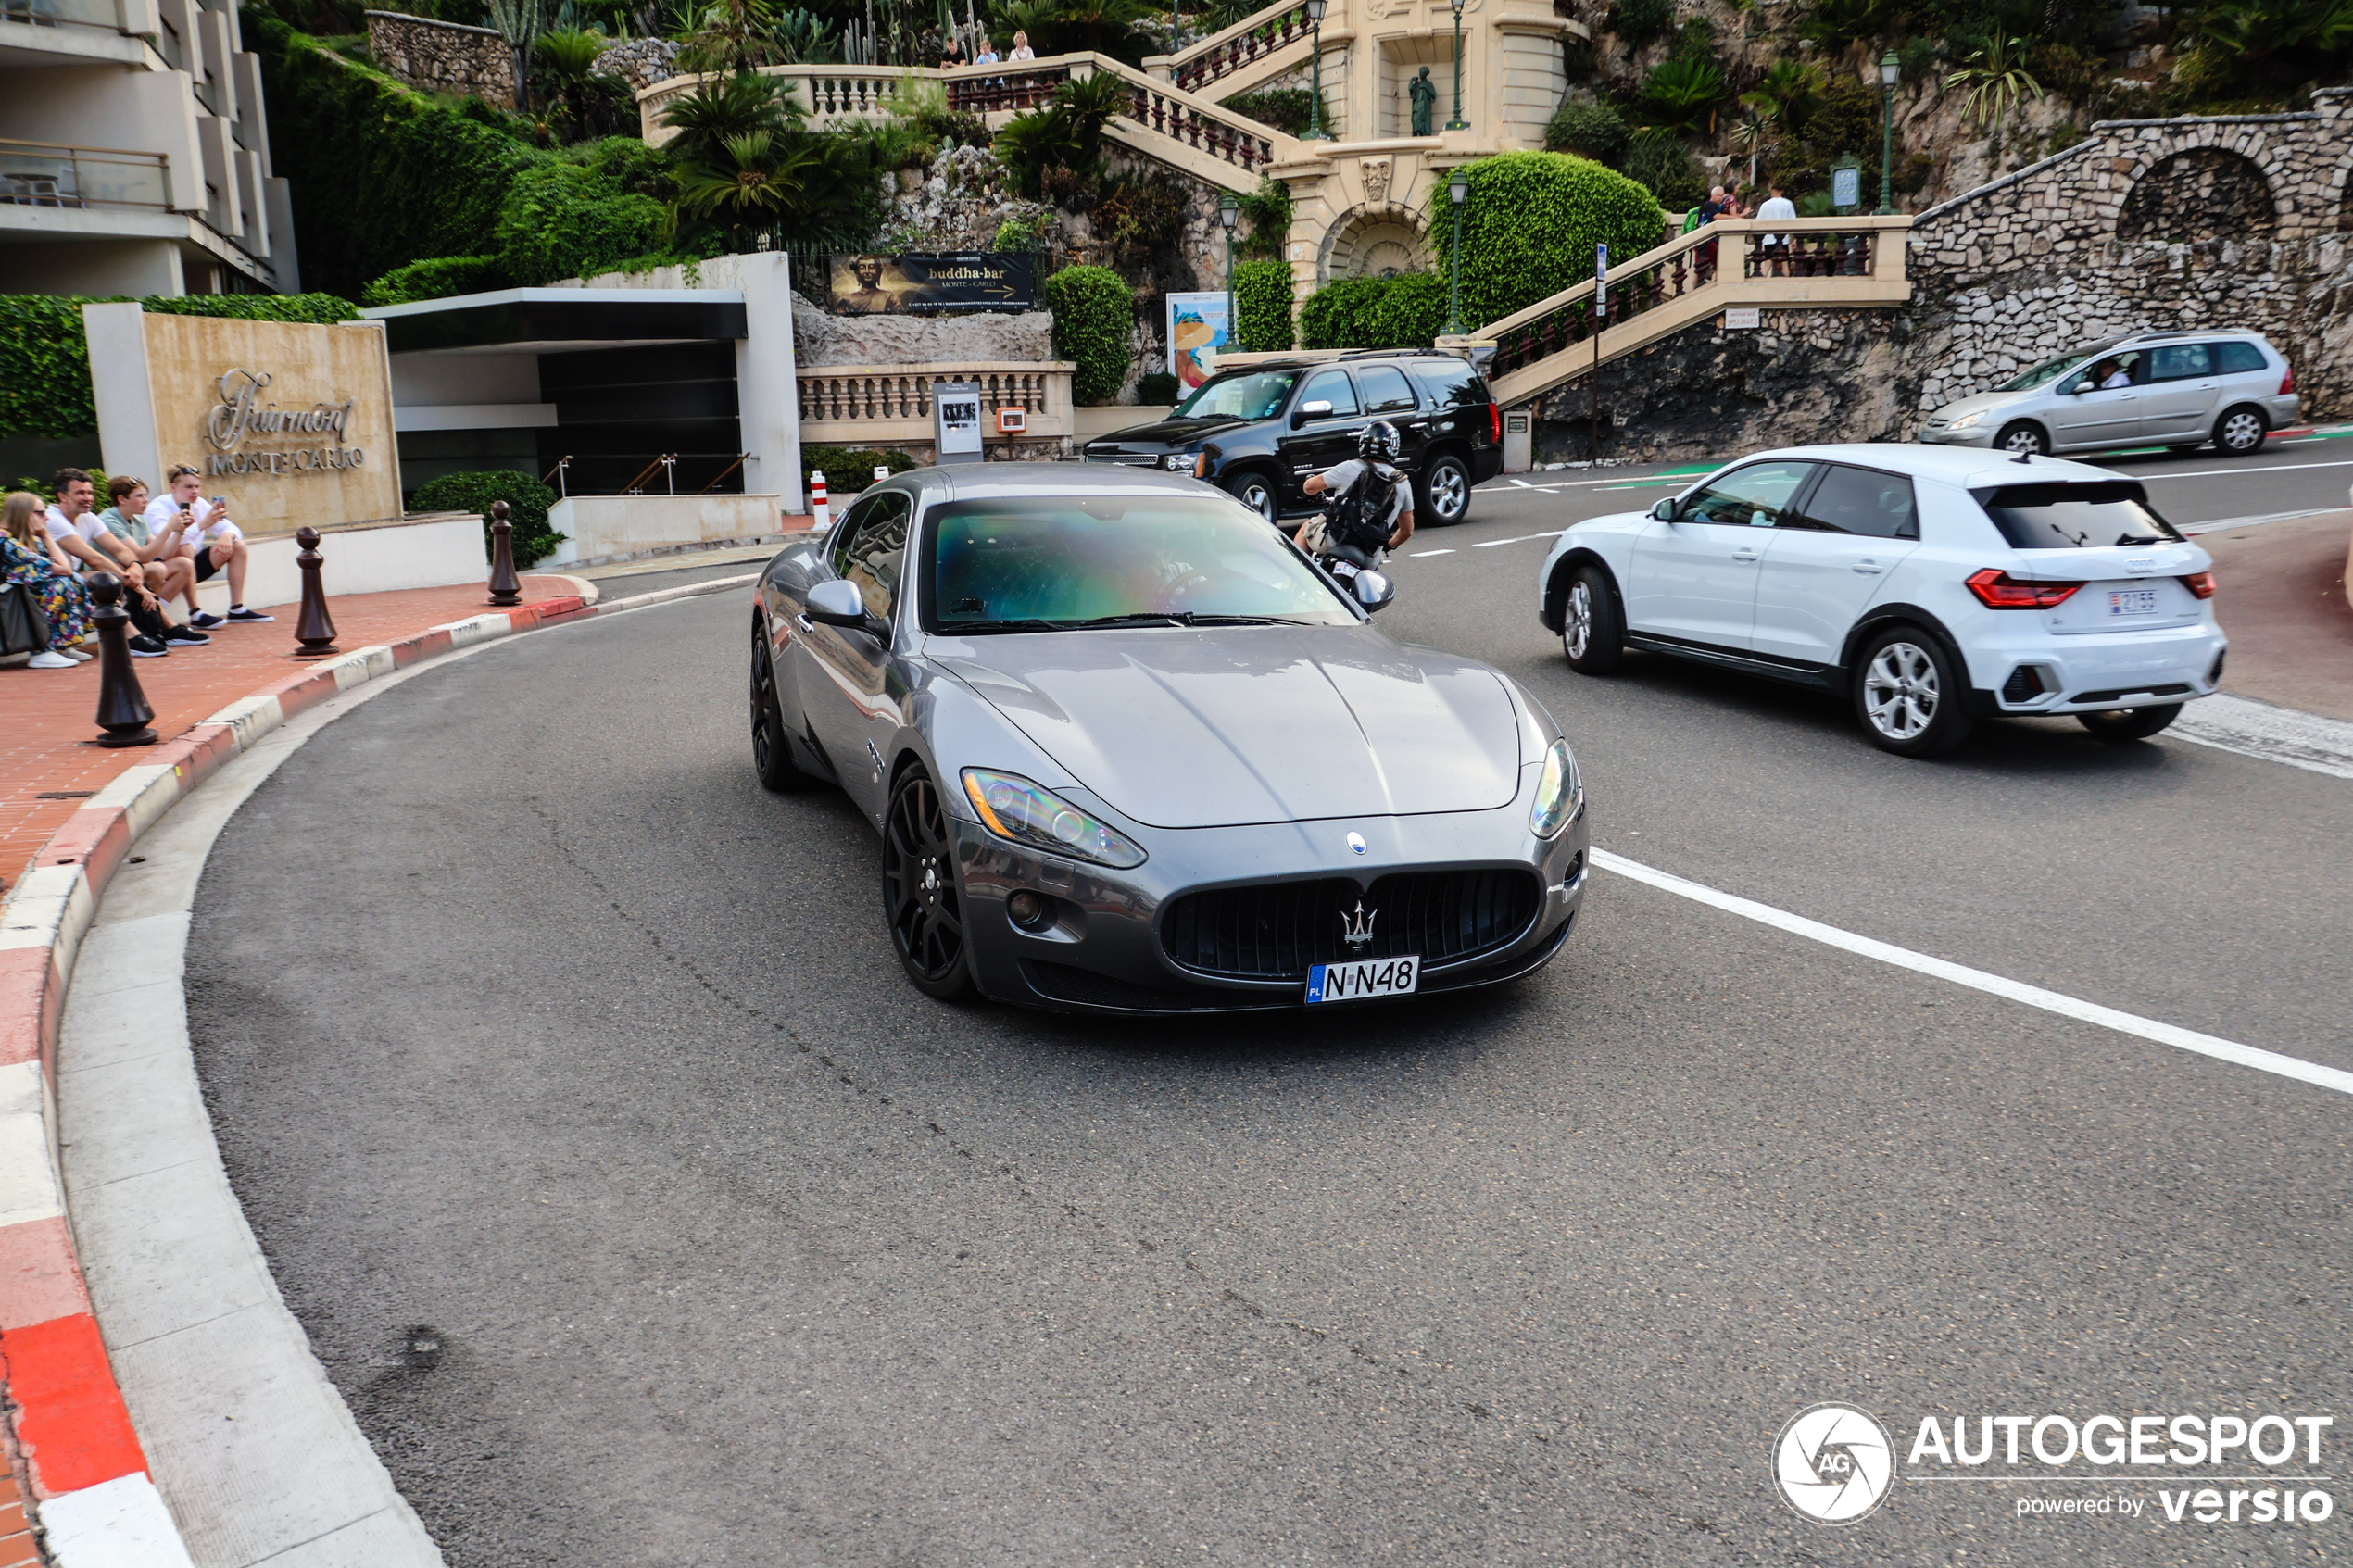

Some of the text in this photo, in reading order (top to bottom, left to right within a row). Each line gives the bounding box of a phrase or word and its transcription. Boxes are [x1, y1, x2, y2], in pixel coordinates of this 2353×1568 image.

[929, 267, 1004, 279] buddha-bar
[208, 369, 356, 450] Fairmont
[206, 448, 364, 477] MONTE CARLO
[1309, 987, 1321, 997] PL
